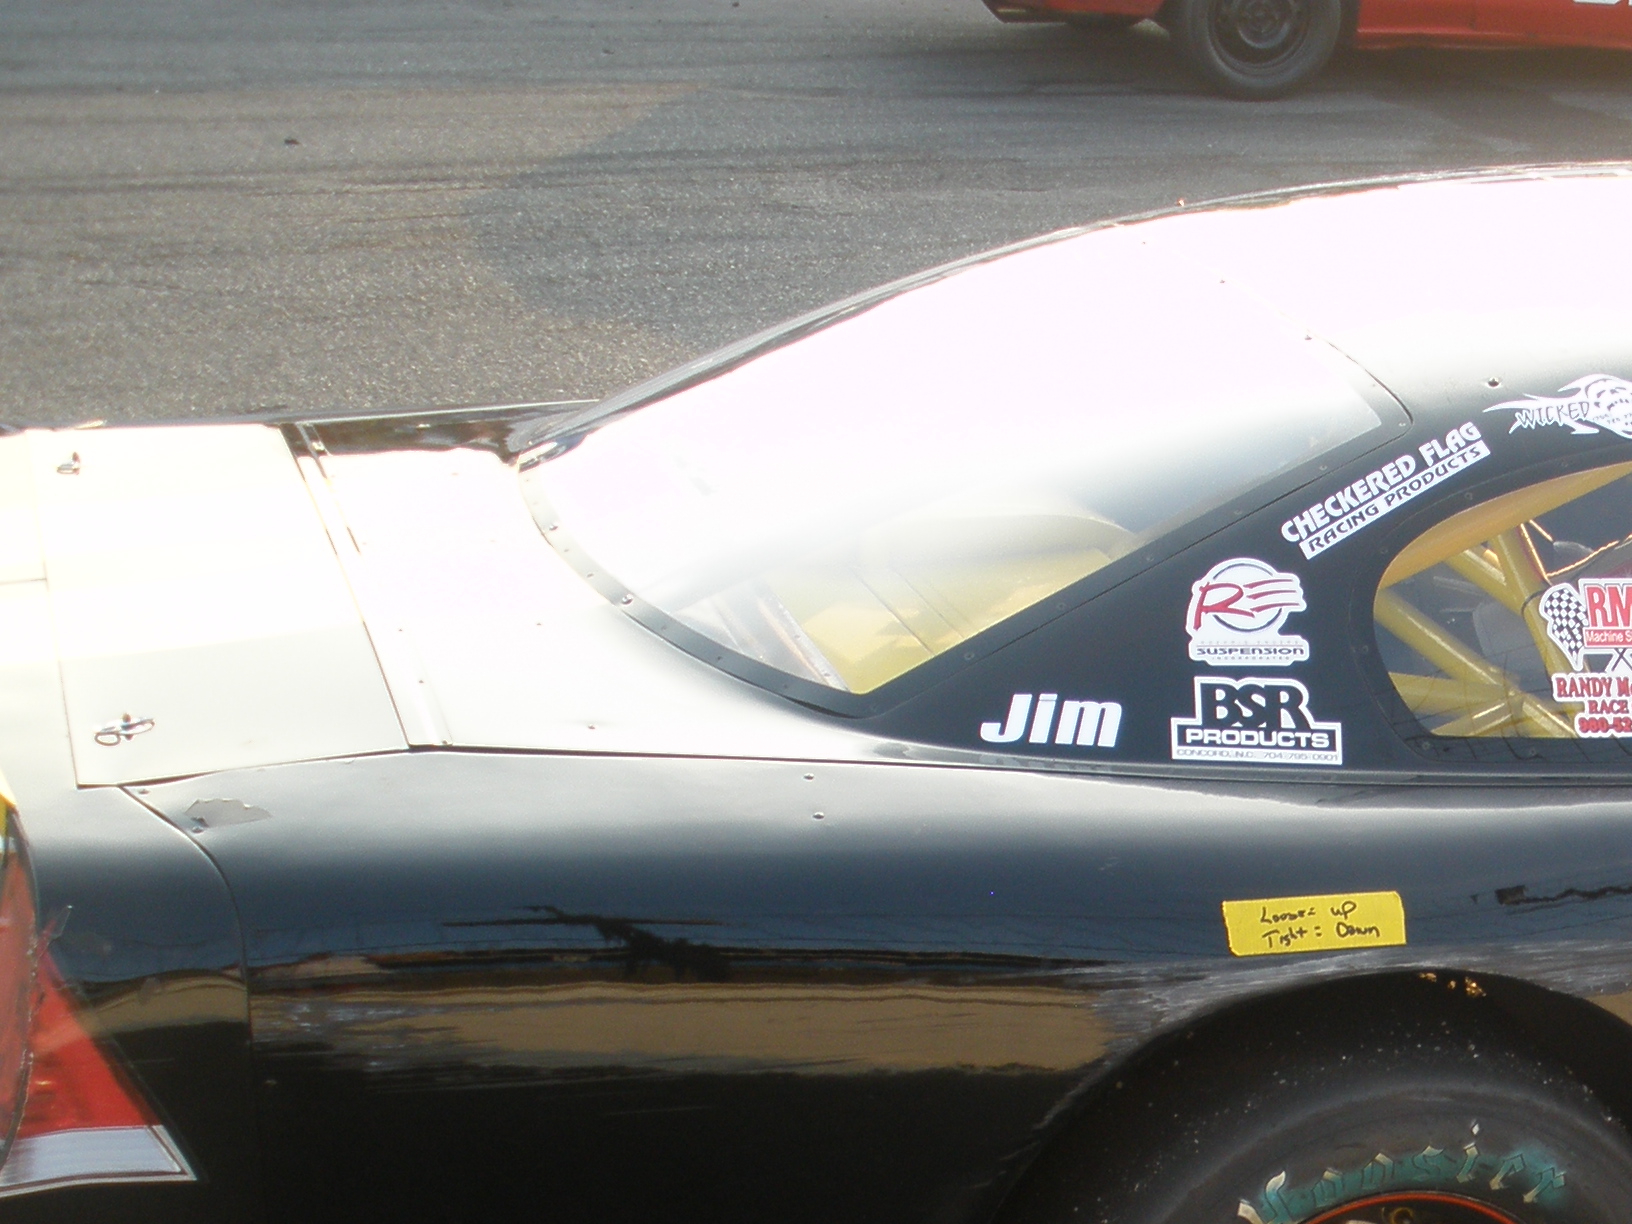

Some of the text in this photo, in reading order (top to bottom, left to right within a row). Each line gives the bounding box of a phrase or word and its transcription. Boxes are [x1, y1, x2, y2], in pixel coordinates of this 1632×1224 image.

[1281, 421, 1481, 542] CHECKERED FLAG
[1308, 446, 1481, 552] RACING PRODUCTS
[1586, 630, 1623, 643] Machine
[1555, 677, 1612, 698] RANDY
[980, 693, 1122, 748] Jim
[1200, 683, 1312, 729] BSR
[1588, 700, 1629, 714] RACE
[1186, 729, 1330, 748] PRODUCTS
